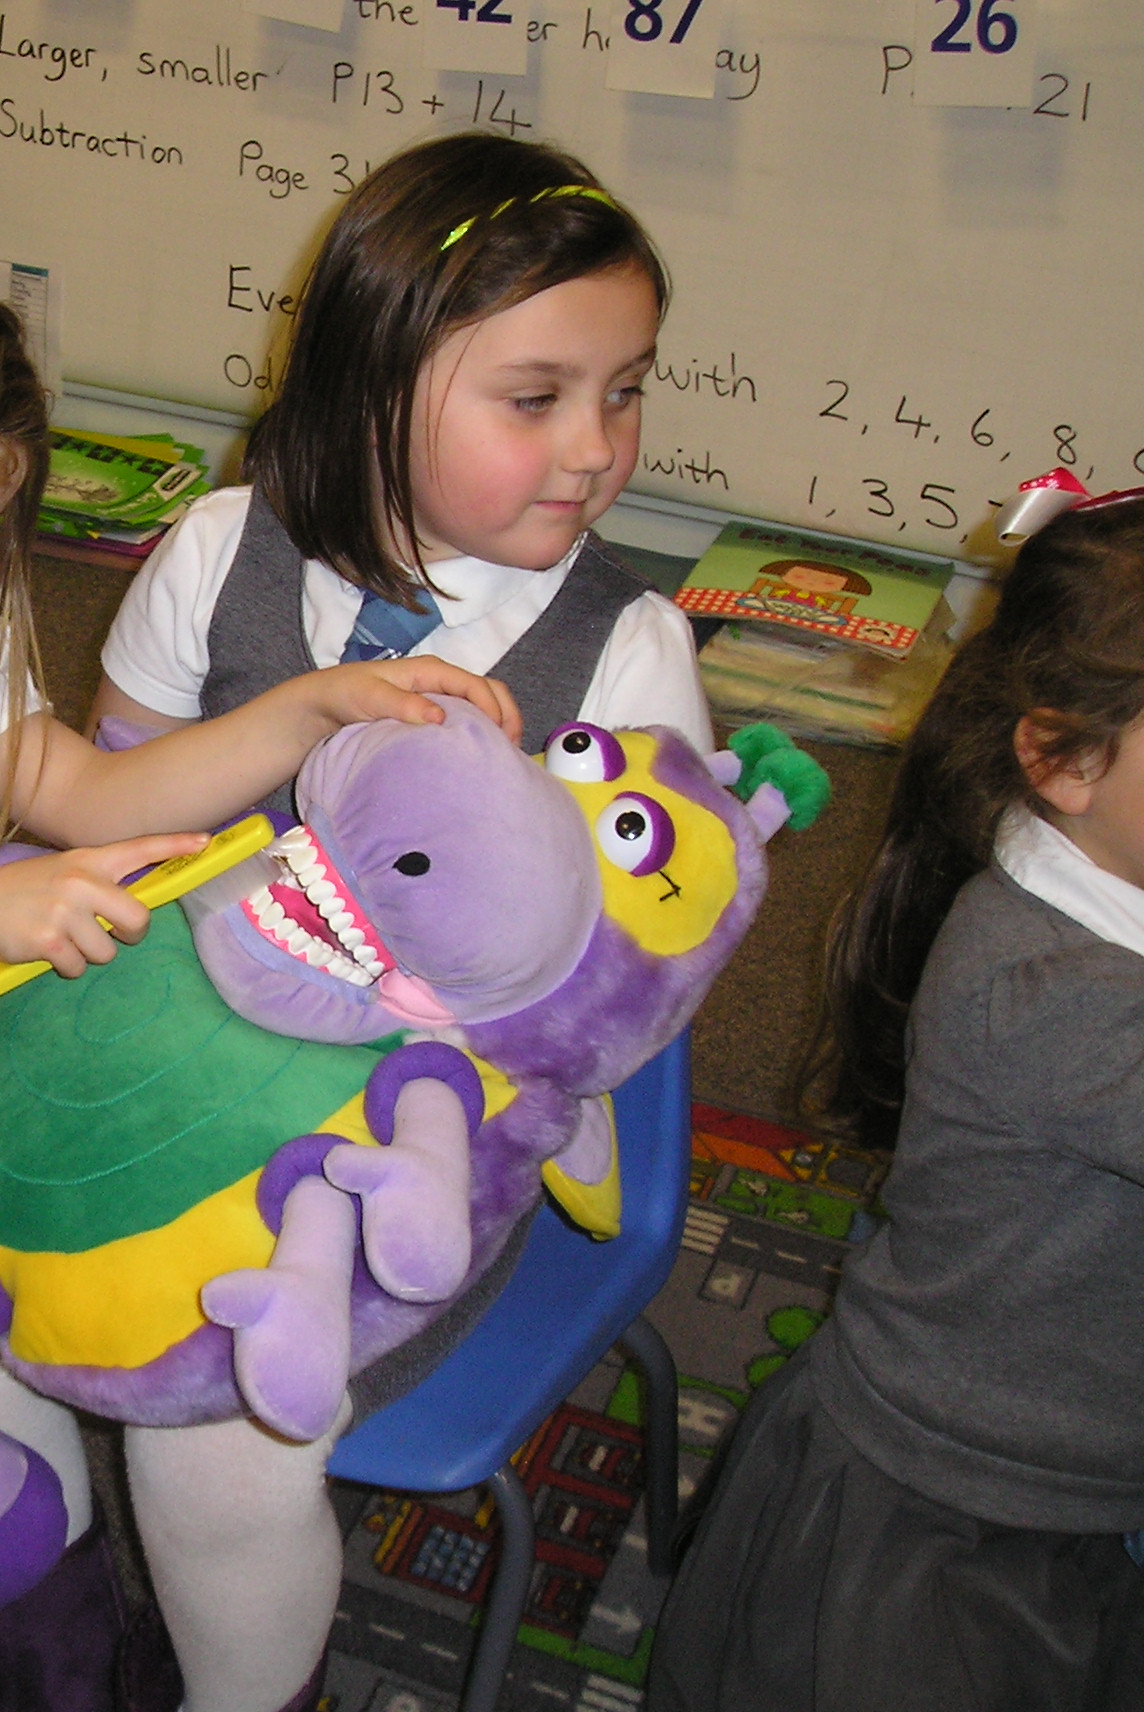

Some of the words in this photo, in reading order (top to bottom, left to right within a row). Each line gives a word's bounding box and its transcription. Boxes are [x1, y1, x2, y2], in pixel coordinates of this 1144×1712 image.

[583, 8, 611, 51] h
[1033, 73, 1090, 121] 21
[930, 0, 1018, 54] 26
[137, 44, 268, 91] smaller
[332, 62, 403, 114] P13
[473, 80, 532, 136] 14
[239, 140, 309, 199] Page
[655, 352, 756, 402] with
[819, 380, 868, 435] 2,
[971, 409, 1010, 462] 6,
[1053, 424, 1094, 480] 8,
[644, 448, 729, 490] with
